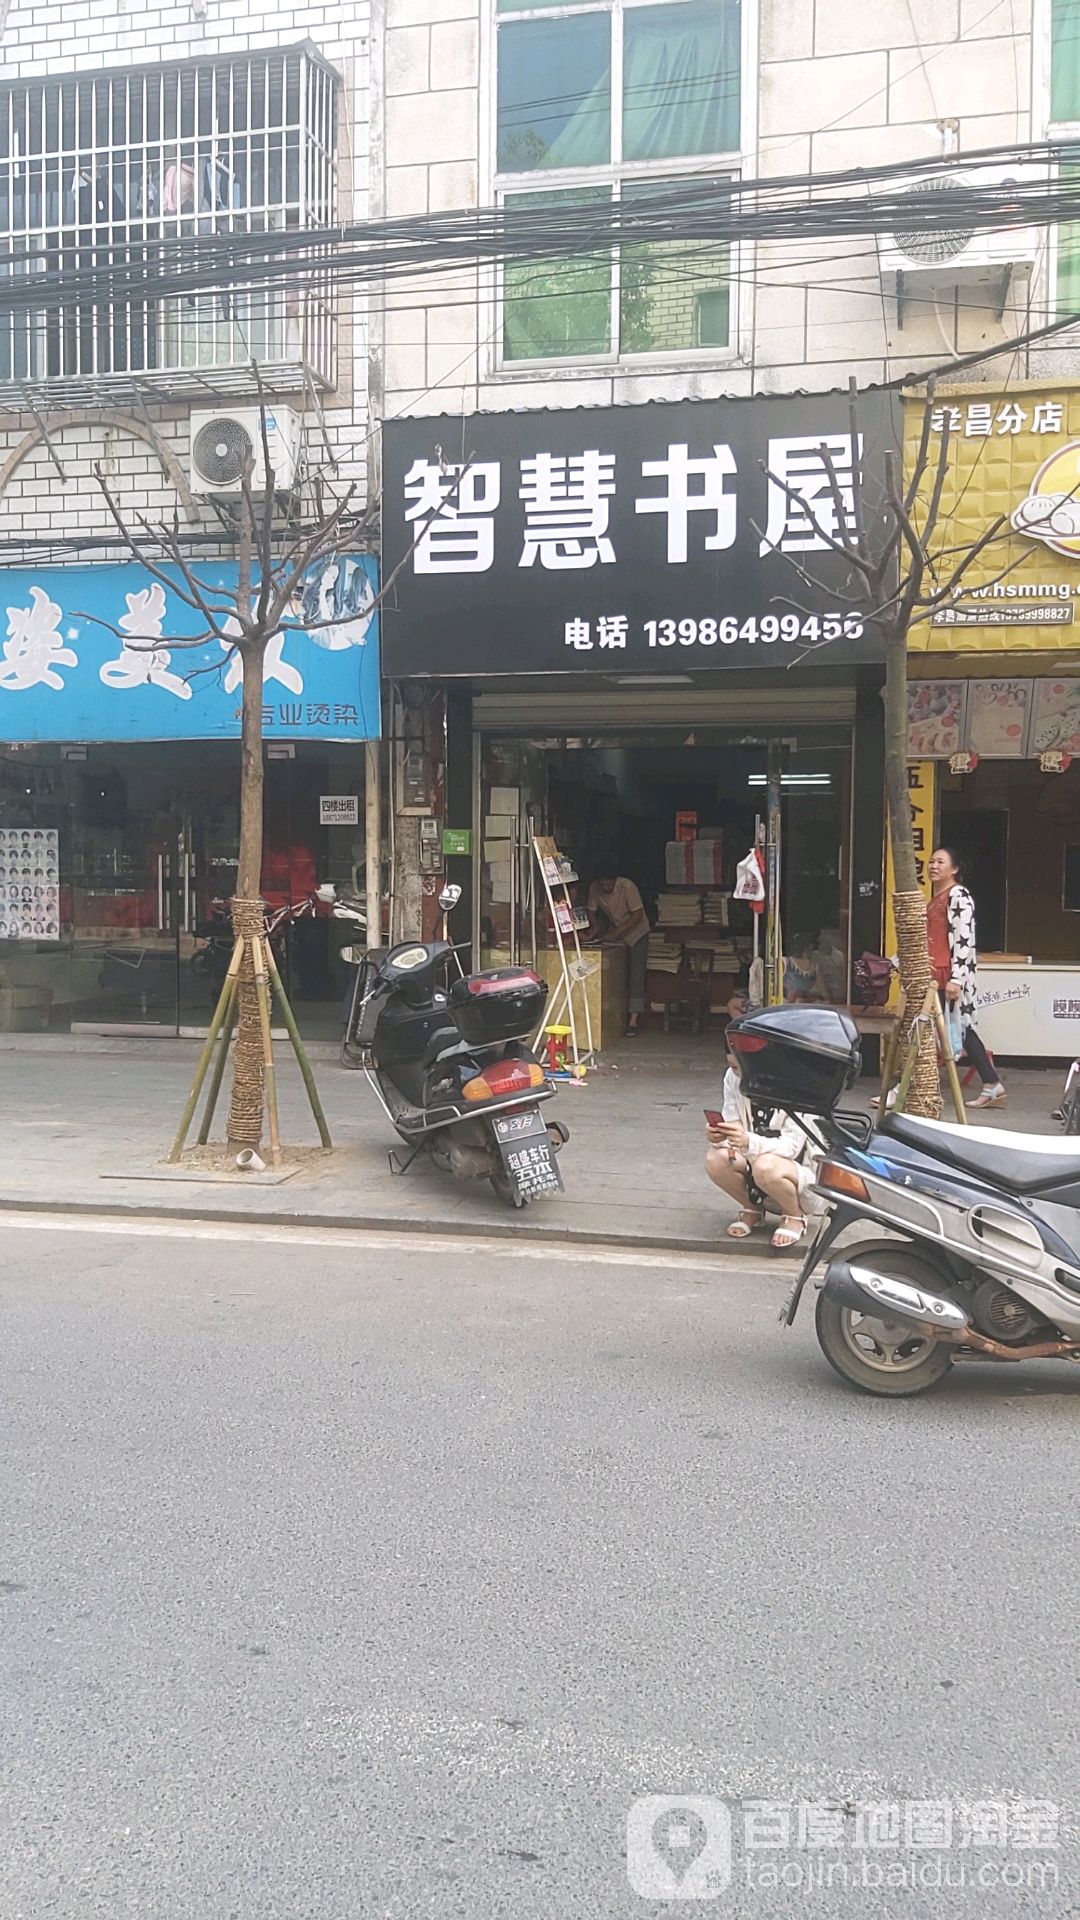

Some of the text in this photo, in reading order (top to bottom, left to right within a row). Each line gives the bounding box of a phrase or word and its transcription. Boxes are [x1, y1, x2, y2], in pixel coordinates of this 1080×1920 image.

[931, 402, 1063, 437] 孝昌分店
[404, 432, 864, 575] 智慧书屋
[565, 611, 864, 650] 电话 13986499456
